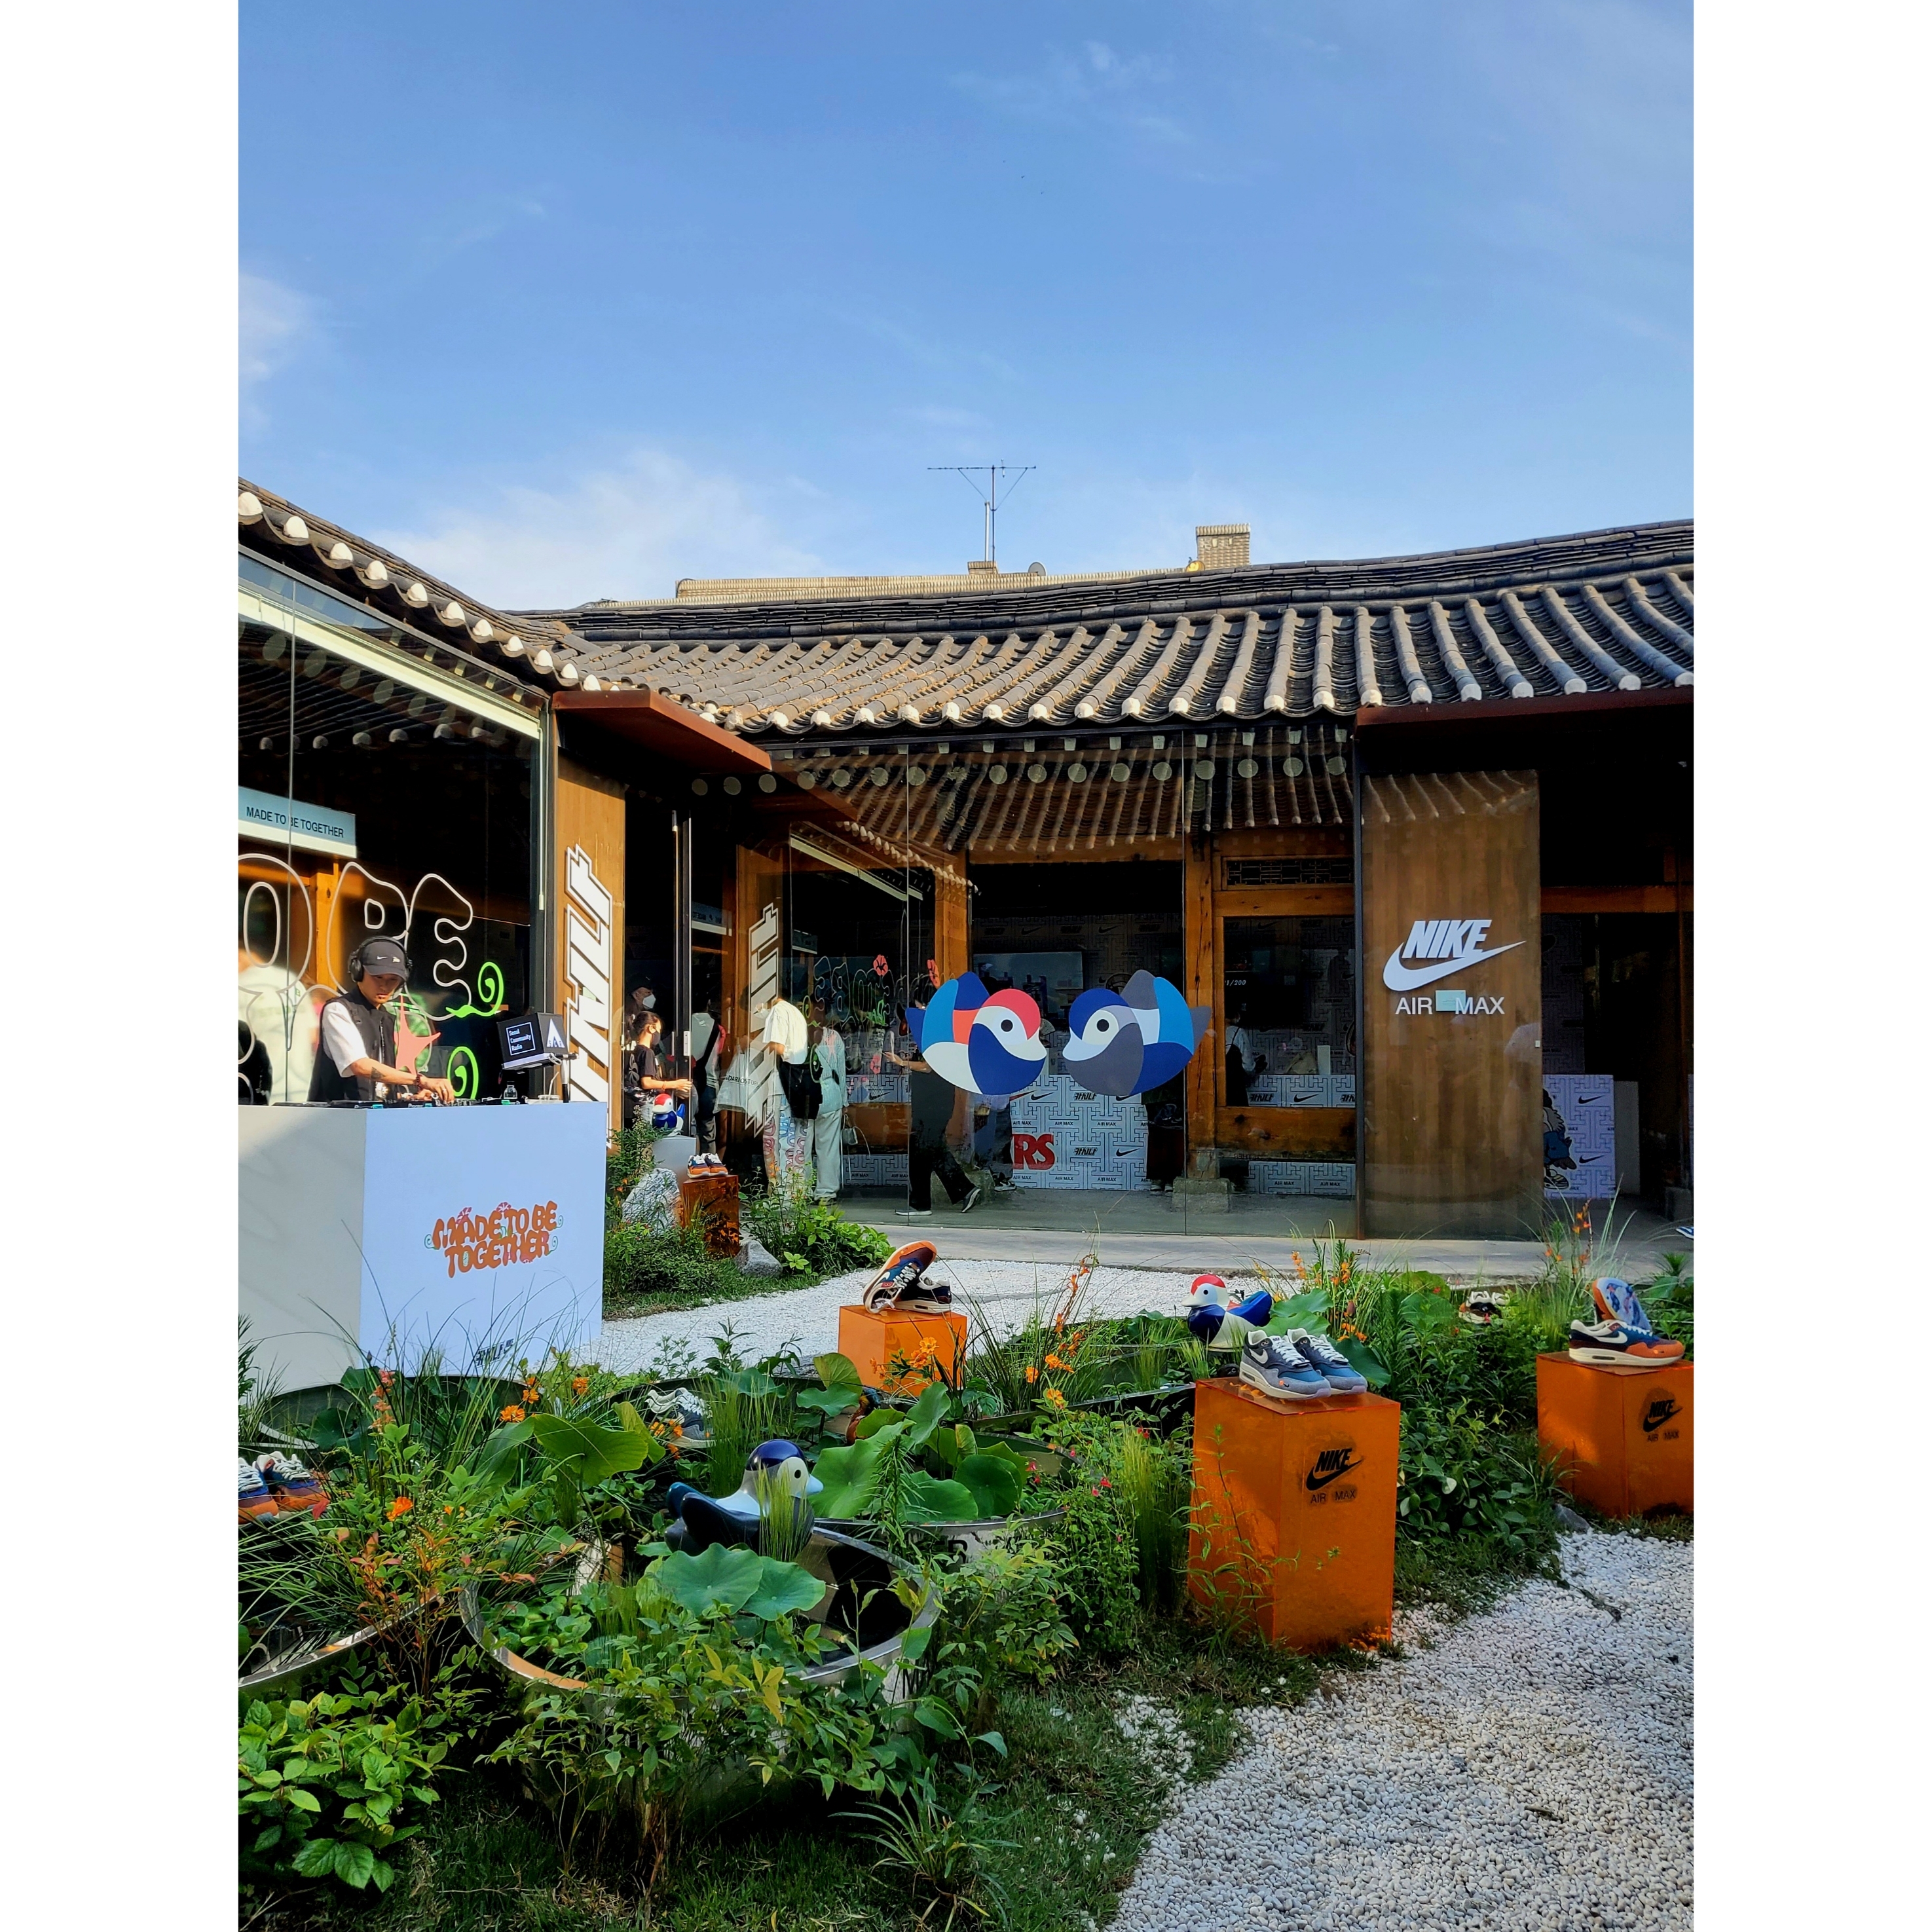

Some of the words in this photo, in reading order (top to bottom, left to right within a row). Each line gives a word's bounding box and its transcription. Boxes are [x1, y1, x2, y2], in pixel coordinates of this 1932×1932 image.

[246, 806, 272, 822] MADE
[274, 813, 286, 825] TO
[301, 819, 344, 838] TOGETHER
[1402, 920, 1492, 959] NIKE
[1395, 997, 1433, 1014] AIR
[1455, 997, 1505, 1014] MAX
[432, 1210, 502, 1250] MADE
[504, 1208, 530, 1235] TO
[532, 1200, 557, 1232] BE
[444, 1230, 550, 1278] TOGETHER
[1314, 1448, 1352, 1473] NIKE
[1310, 1493, 1326, 1504] AIR
[1335, 1490, 1356, 1501] MAX
